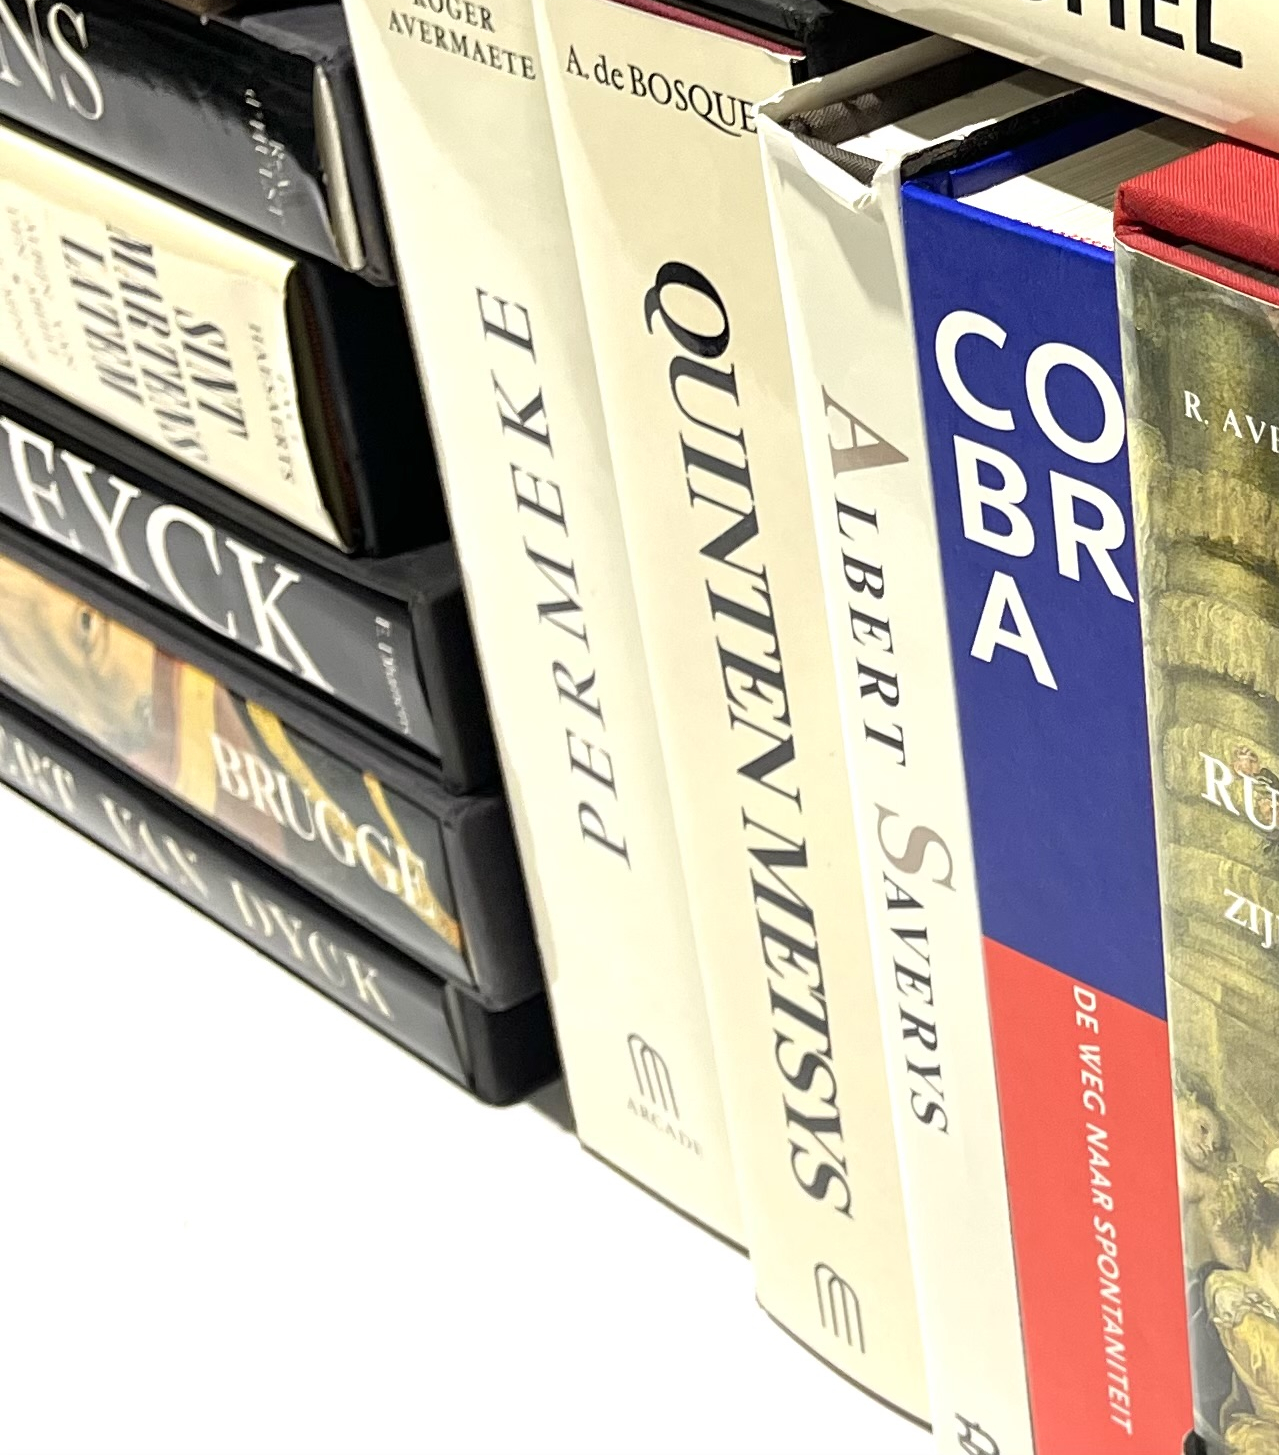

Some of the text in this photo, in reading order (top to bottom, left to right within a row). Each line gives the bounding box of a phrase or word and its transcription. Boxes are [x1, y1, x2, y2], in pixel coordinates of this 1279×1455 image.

[388, 10, 537, 82] AVERMAETE
[566, 45, 758, 138] A. de BOSQUE
[60, 235, 145, 407] LATEM
[106, 221, 209, 463] MARTENS
[173, 305, 249, 440] SINT
[935, 309, 1126, 464] CO
[1183, 390, 1209, 427] R.
[0, 416, 336, 695] EYCK
[475, 286, 631, 871] PERMEKE
[953, 434, 1135, 603] BR
[970, 570, 1059, 691] A
[643, 260, 854, 1220] QUINTEN METSYS
[821, 384, 957, 1135] ALBERT SAVERYS
[210, 733, 441, 919] BRUGGE
[229, 879, 395, 1021] DYCK
[1073, 984, 1134, 1437] DE WEG NAAR SPONTANITEIT
